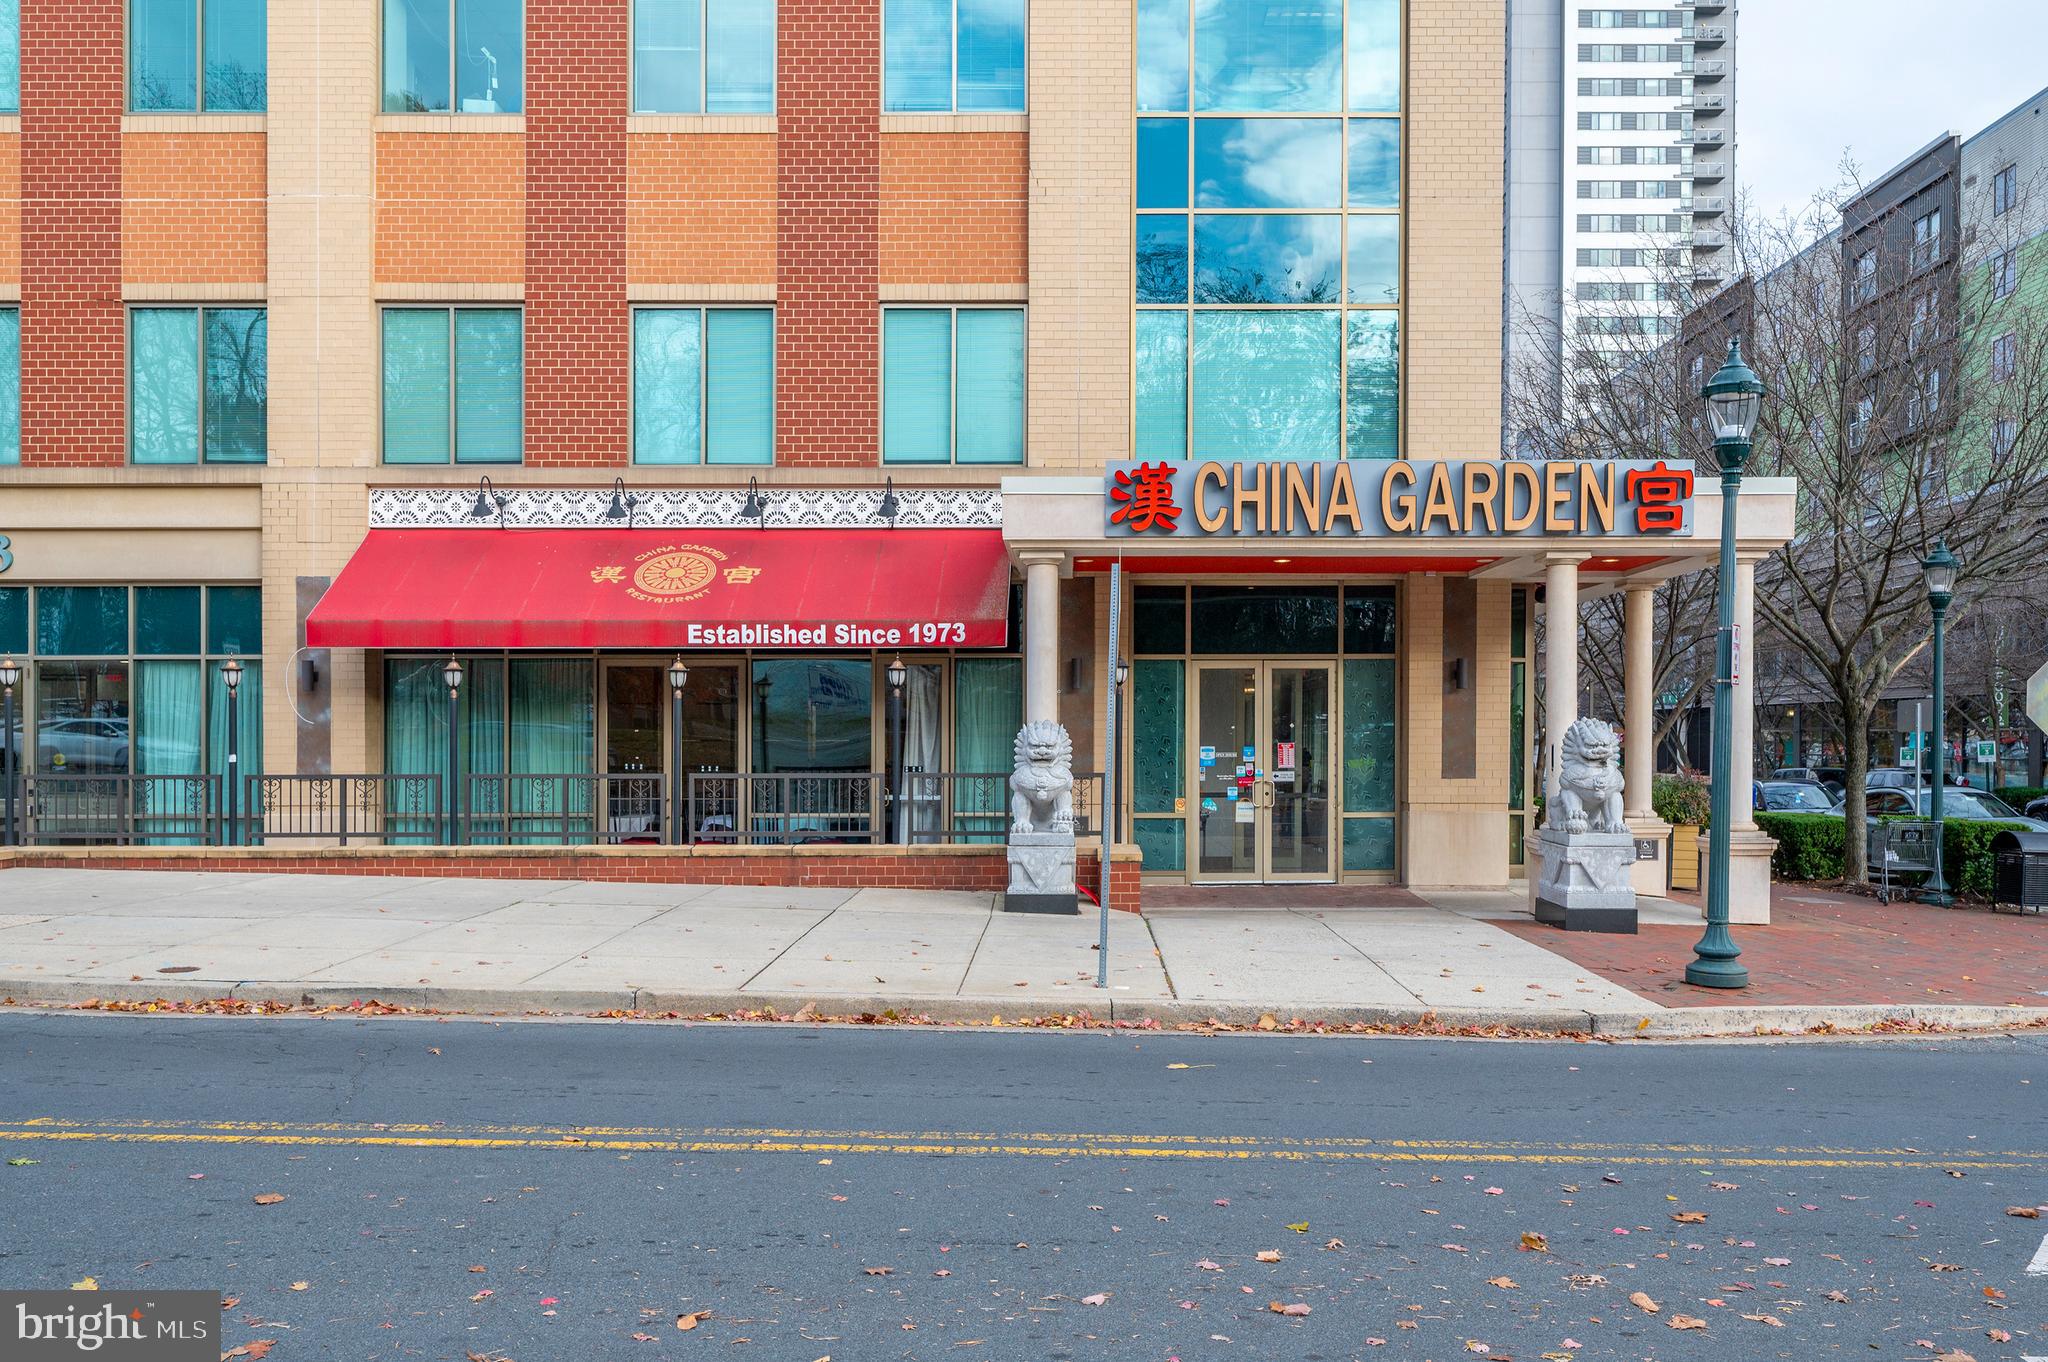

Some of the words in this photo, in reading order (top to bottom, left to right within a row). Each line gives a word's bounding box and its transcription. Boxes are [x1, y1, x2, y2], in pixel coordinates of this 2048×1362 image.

[1110, 461, 1183, 533] 漢
[1193, 461, 1364, 533] CHINA
[1381, 461, 1616, 533] GARDEN
[634, 545, 677, 562] CHINA
[680, 543, 729, 562] GARDEN
[625, 587, 712, 604] RESTAURANT
[687, 624, 827, 645] Established
[834, 624, 901, 645] Since
[908, 622, 966, 643] 1973
